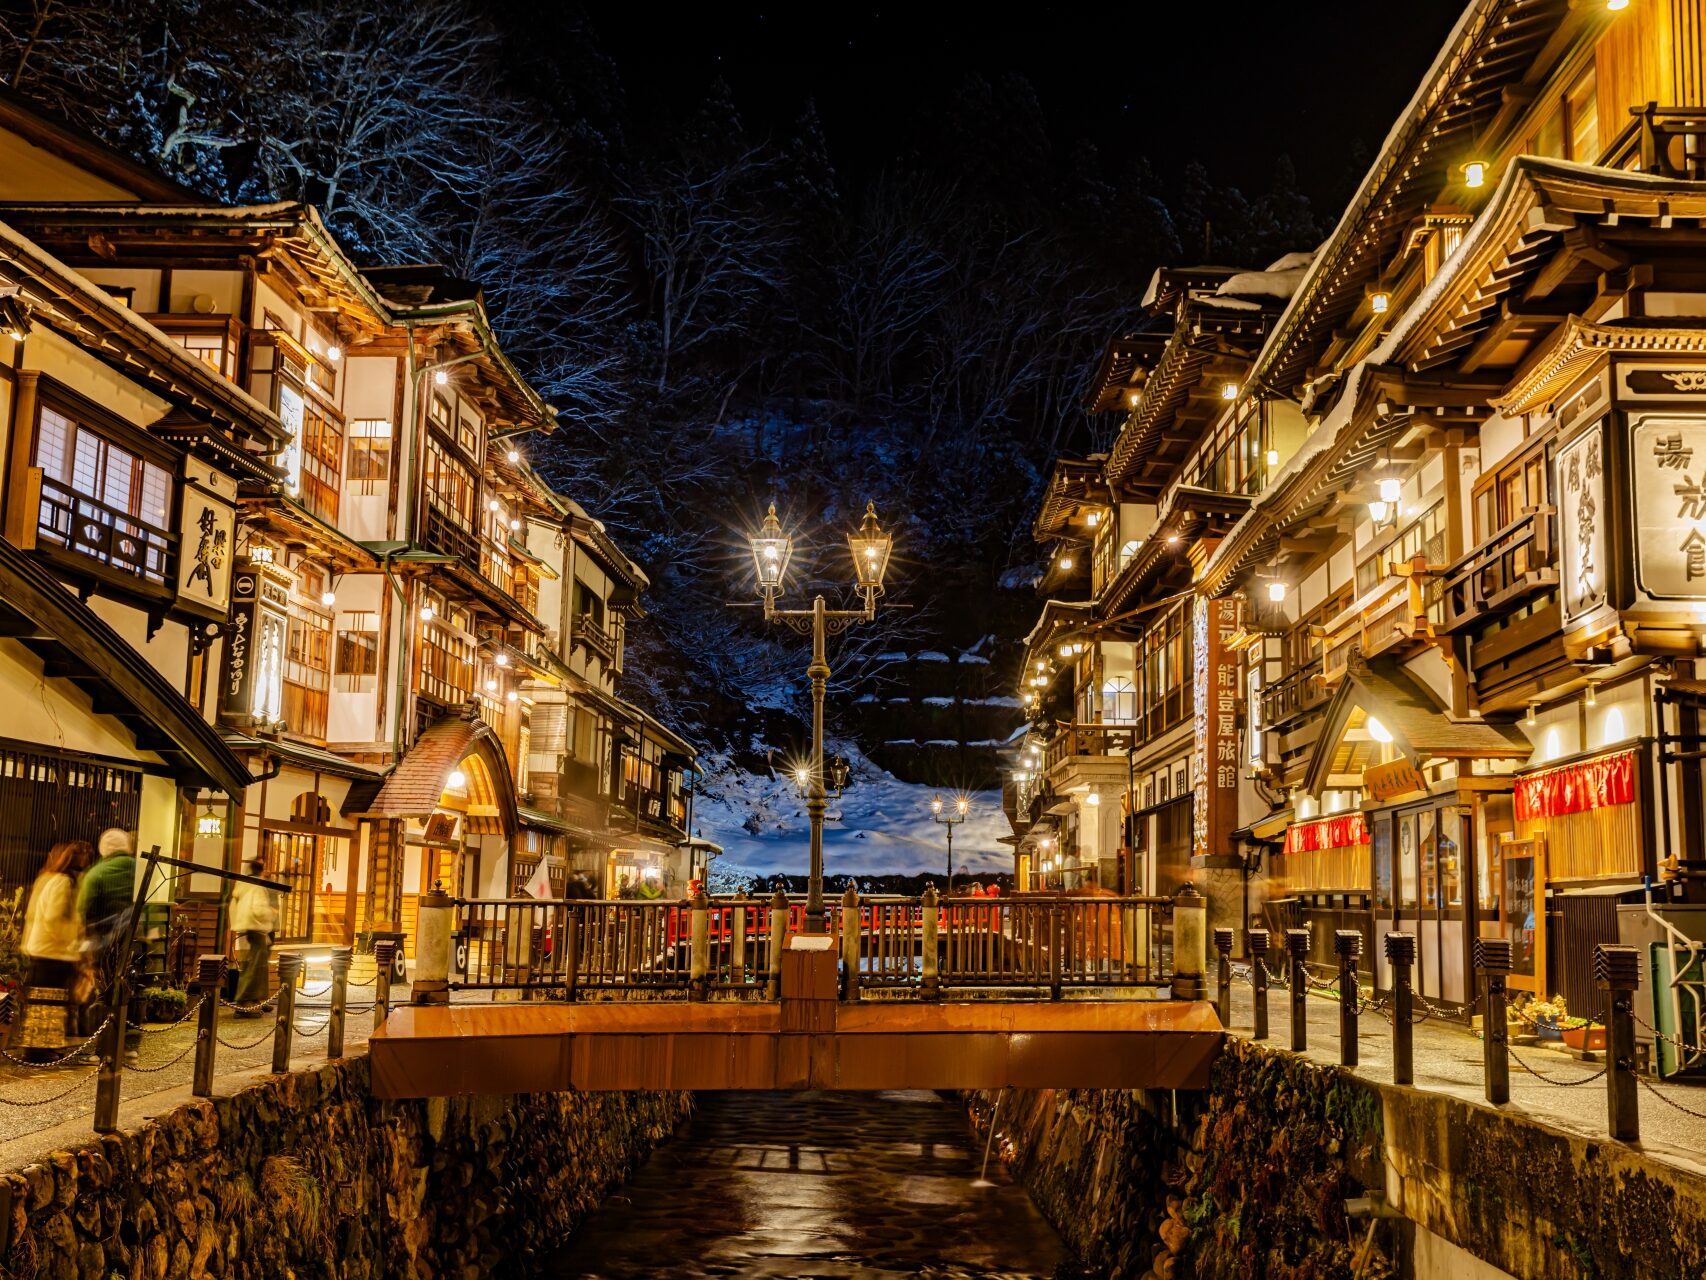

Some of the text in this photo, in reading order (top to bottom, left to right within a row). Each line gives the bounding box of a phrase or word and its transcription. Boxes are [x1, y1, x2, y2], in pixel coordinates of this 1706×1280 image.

[1217, 664, 1236, 789] 能登屋旅館
